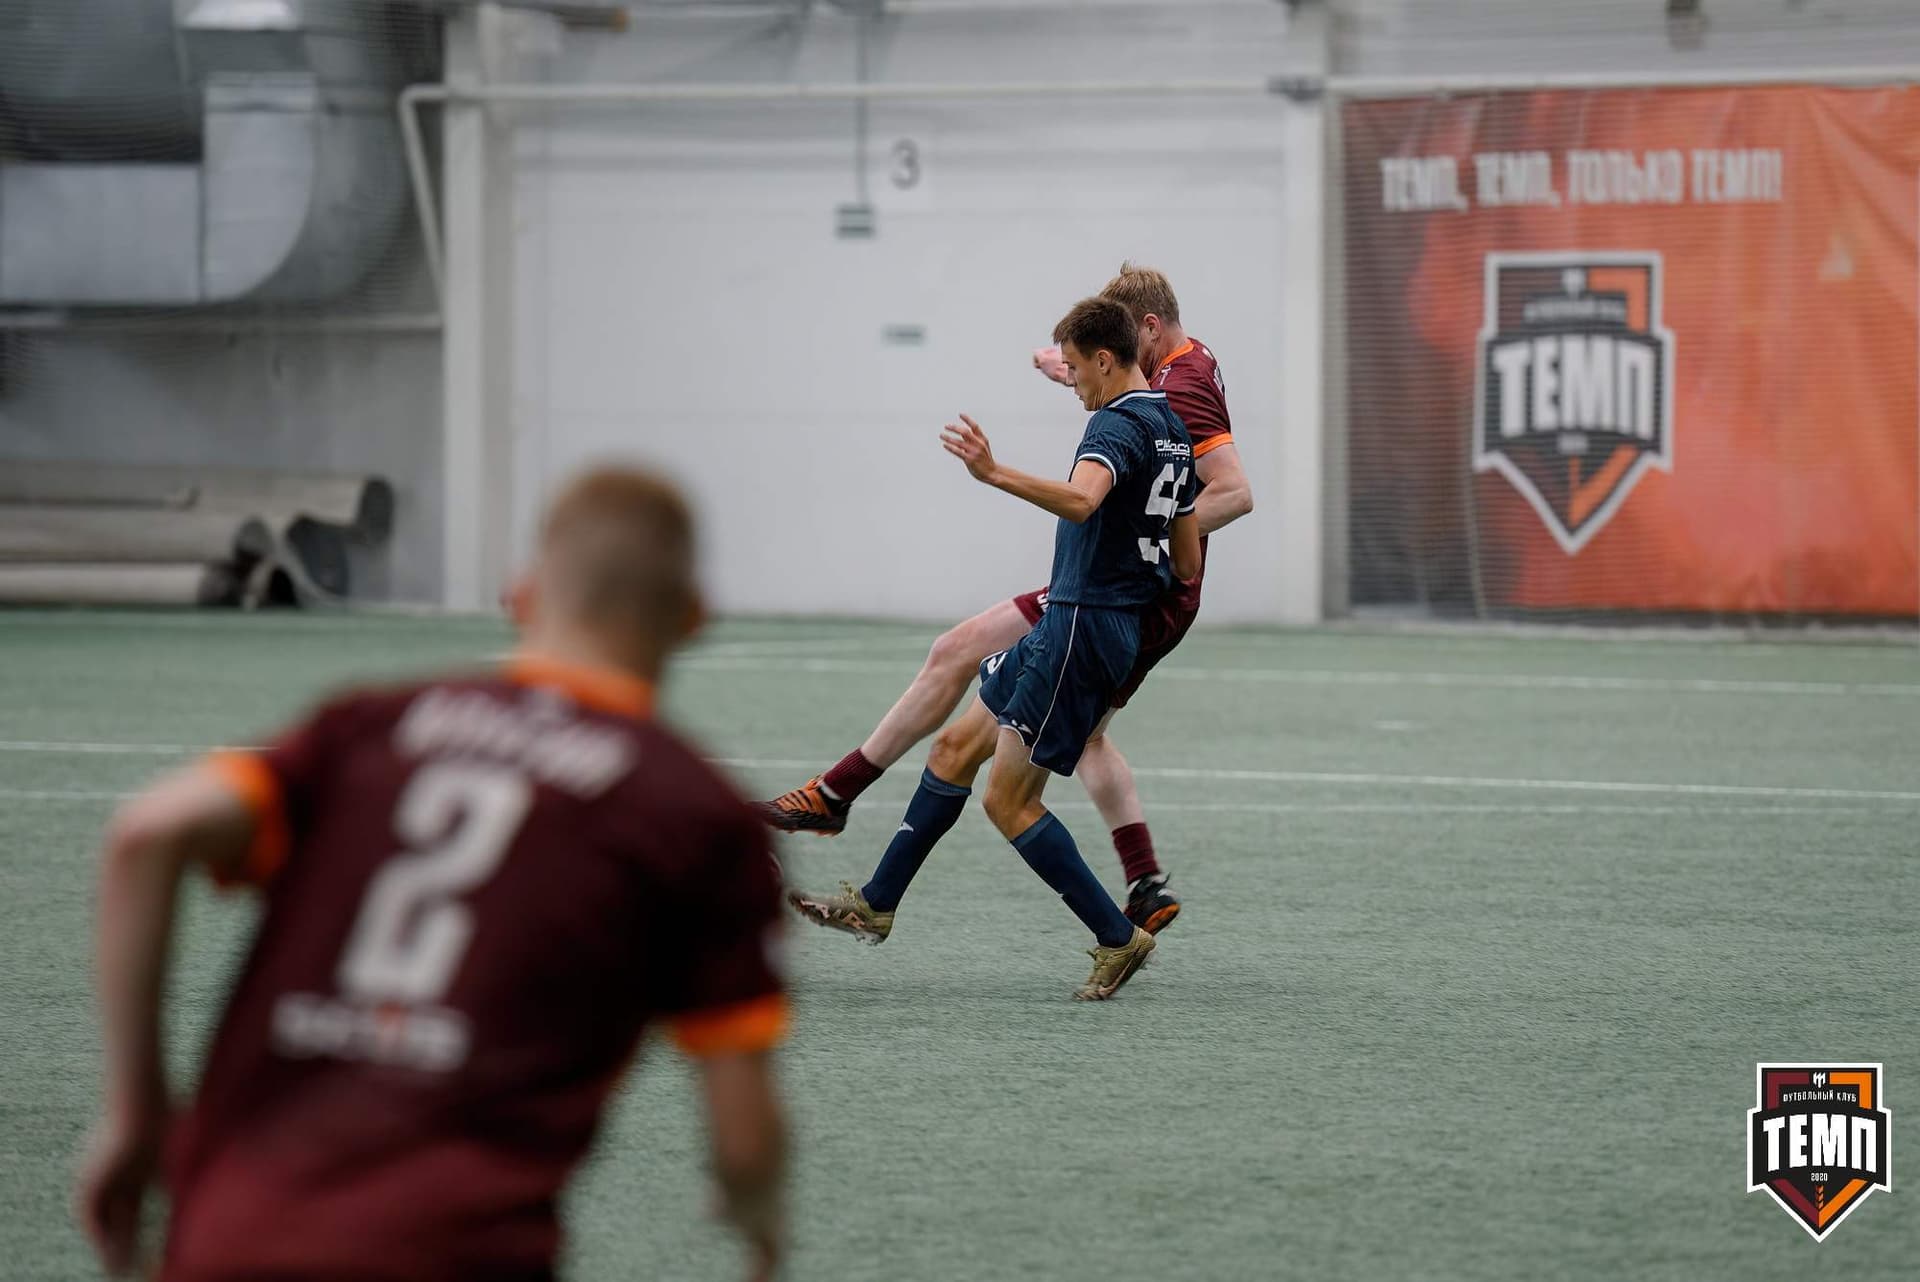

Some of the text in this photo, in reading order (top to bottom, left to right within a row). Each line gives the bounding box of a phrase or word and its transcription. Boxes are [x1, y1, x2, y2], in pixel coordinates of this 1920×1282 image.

[892, 138, 921, 190] 3
[1493, 334, 1655, 440] ТЕМП
[338, 758, 531, 1001] 2
